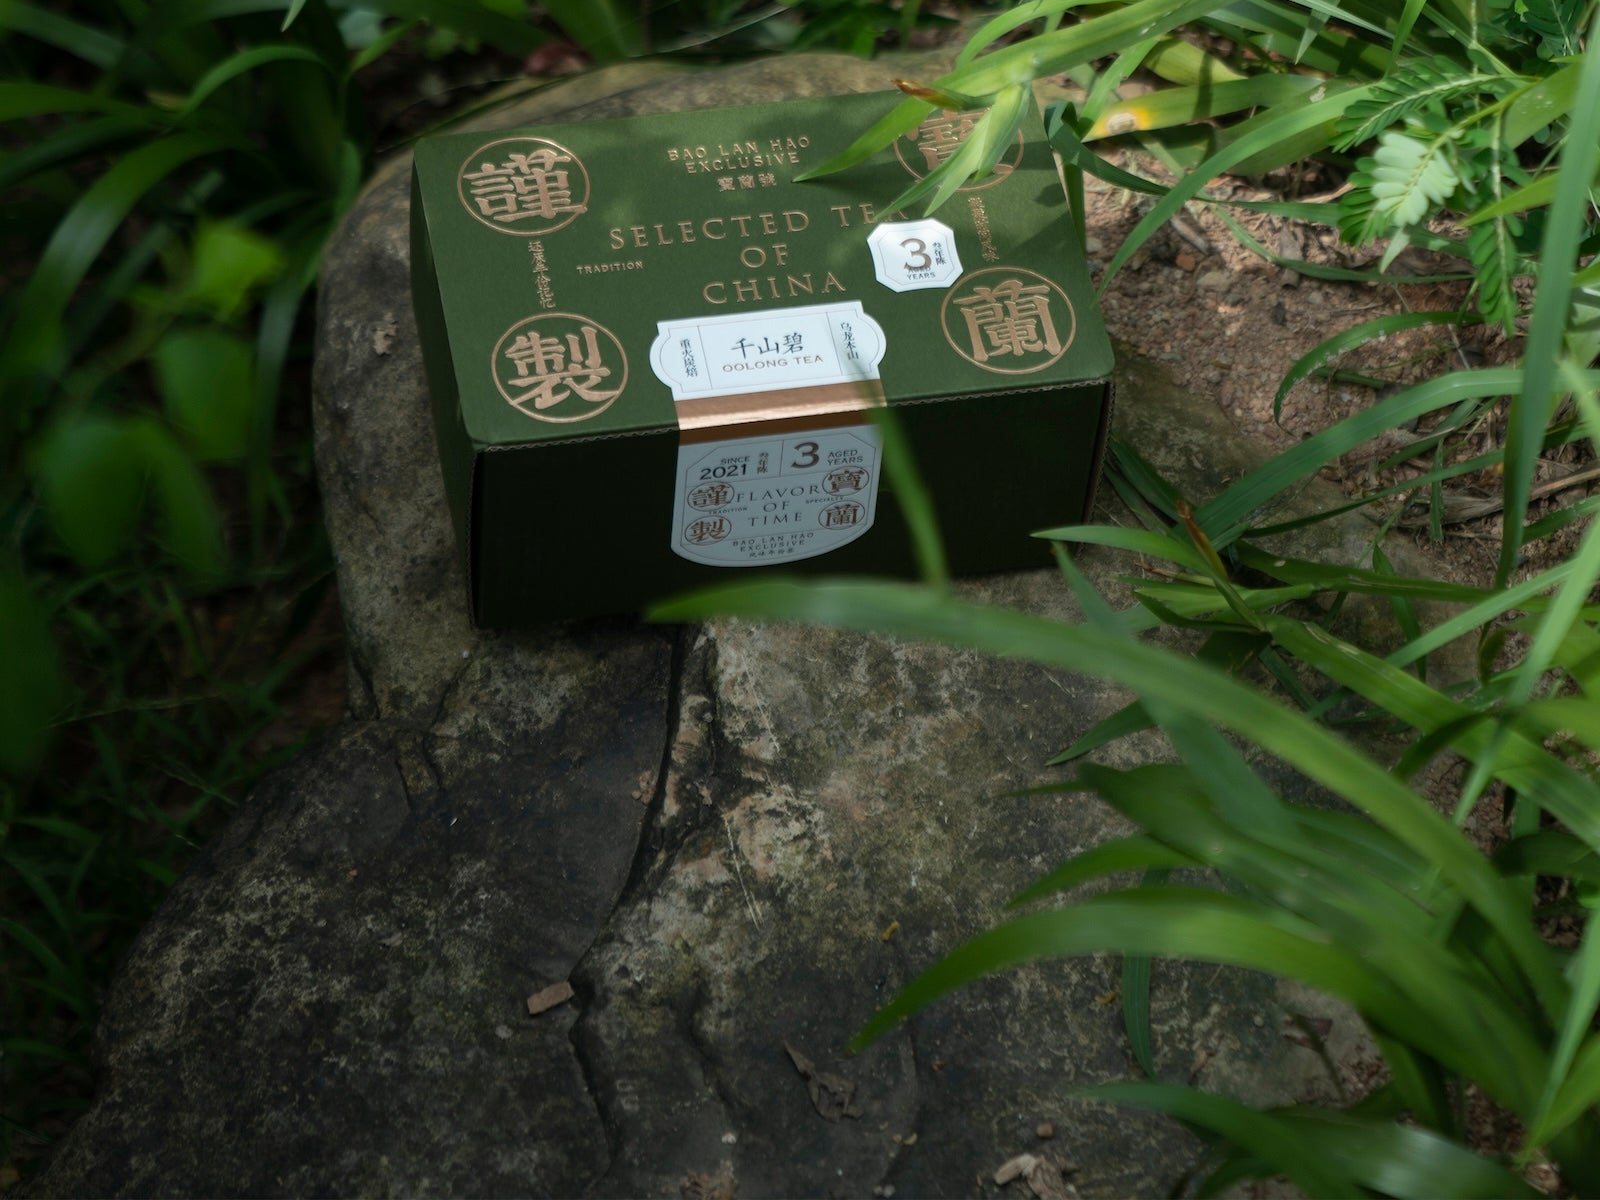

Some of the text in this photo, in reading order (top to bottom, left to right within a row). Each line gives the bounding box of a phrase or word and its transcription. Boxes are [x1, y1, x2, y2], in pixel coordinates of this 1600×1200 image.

[668, 136, 811, 162] BAO LAN HAO
[685, 152, 800, 174] EXCLUSIVE
[463, 148, 588, 223] 謹
[609, 210, 810, 251] SELECTED
[739, 243, 789, 269] OF
[899, 238, 932, 270] 3
[576, 260, 644, 275] TRADITION
[907, 272, 936, 280] YEARS
[702, 271, 847, 304] CHINA
[953, 279, 1062, 362] 蘭
[731, 332, 804, 360] 千山碧
[505, 326, 620, 410] 製
[722, 354, 825, 373] OOLONG TEA
[720, 455, 750, 466] SINCE
[790, 441, 820, 469] 3
[826, 456, 864, 467] YEARS
[827, 449, 858, 459] AGED
[699, 464, 747, 481] 2021
[736, 485, 820, 503] FLAVOR
[763, 500, 790, 513] OF
[747, 512, 803, 527] TIME
[732, 539, 756, 547] BAO
[791, 532, 815, 540] HAO
[740, 539, 805, 552] EXCLUSIVE
